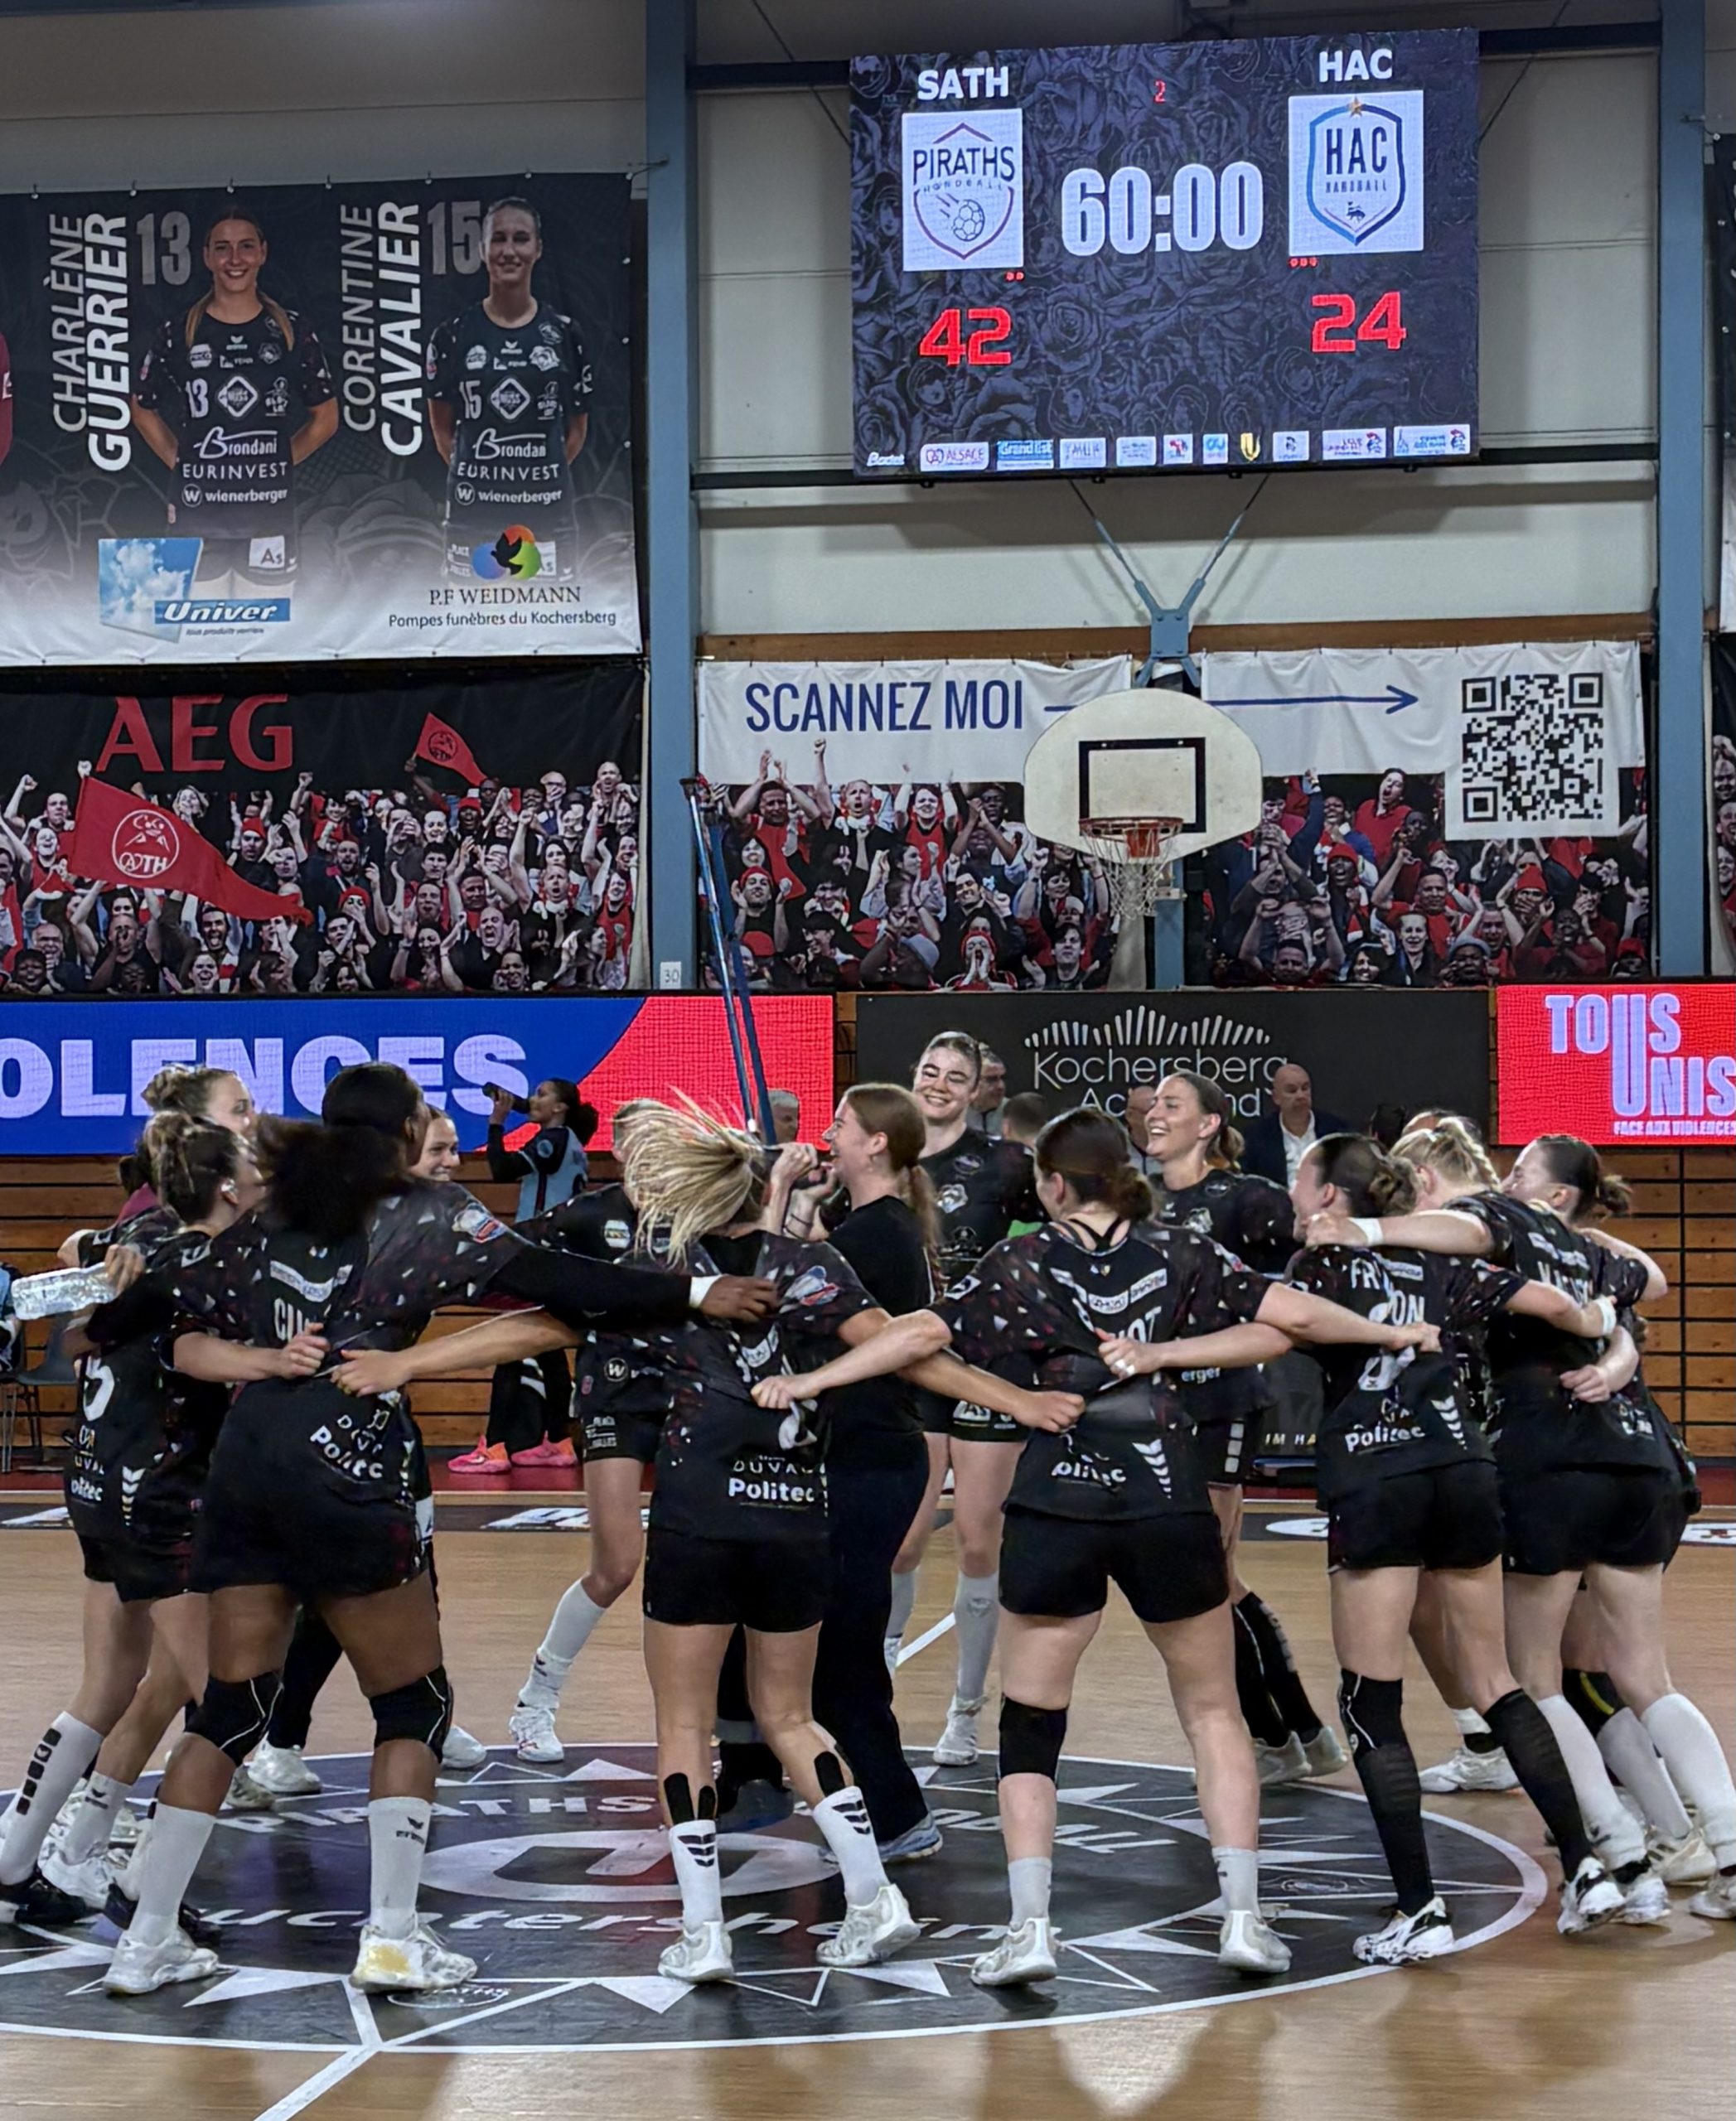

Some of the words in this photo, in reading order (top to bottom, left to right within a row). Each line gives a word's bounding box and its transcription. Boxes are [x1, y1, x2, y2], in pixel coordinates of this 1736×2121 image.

[917, 66, 1009, 100] SATH
[1318, 49, 1393, 83] HAC
[1153, 80, 1167, 103] 2
[913, 146, 1016, 186] PIRATHS
[1326, 127, 1387, 175] HAC
[1061, 161, 1264, 256] 60:00
[136, 211, 192, 285] 13
[428, 201, 481, 274] 15
[43, 214, 87, 432] CHARLÈNE
[340, 205, 376, 432] CORENTINE
[378, 201, 423, 456] CAVALIER
[919, 307, 1012, 365] 42
[1312, 292, 1407, 352] 24
[85, 213, 131, 471] GUERRIER
[185, 378, 209, 418] 13
[459, 380, 481, 419] 15
[193, 426, 278, 459] Brondani
[182, 461, 288, 480] EURINVEST
[457, 462, 560, 481] EURINVEST
[205, 489, 288, 504] wienerberger
[478, 489, 563, 505] wienerberger
[165, 602, 278, 621] Univer
[459, 587, 582, 604] WEIDMANN
[389, 613, 443, 630] Pompes
[447, 611, 506, 627] funèbres
[510, 611, 527, 625] du
[531, 611, 617, 627] Kochersberg
[747, 681, 932, 732] SCANNEZ
[945, 679, 1023, 731] MOI
[95, 694, 294, 772] AEG
[728, 1477, 815, 1502] Politec
